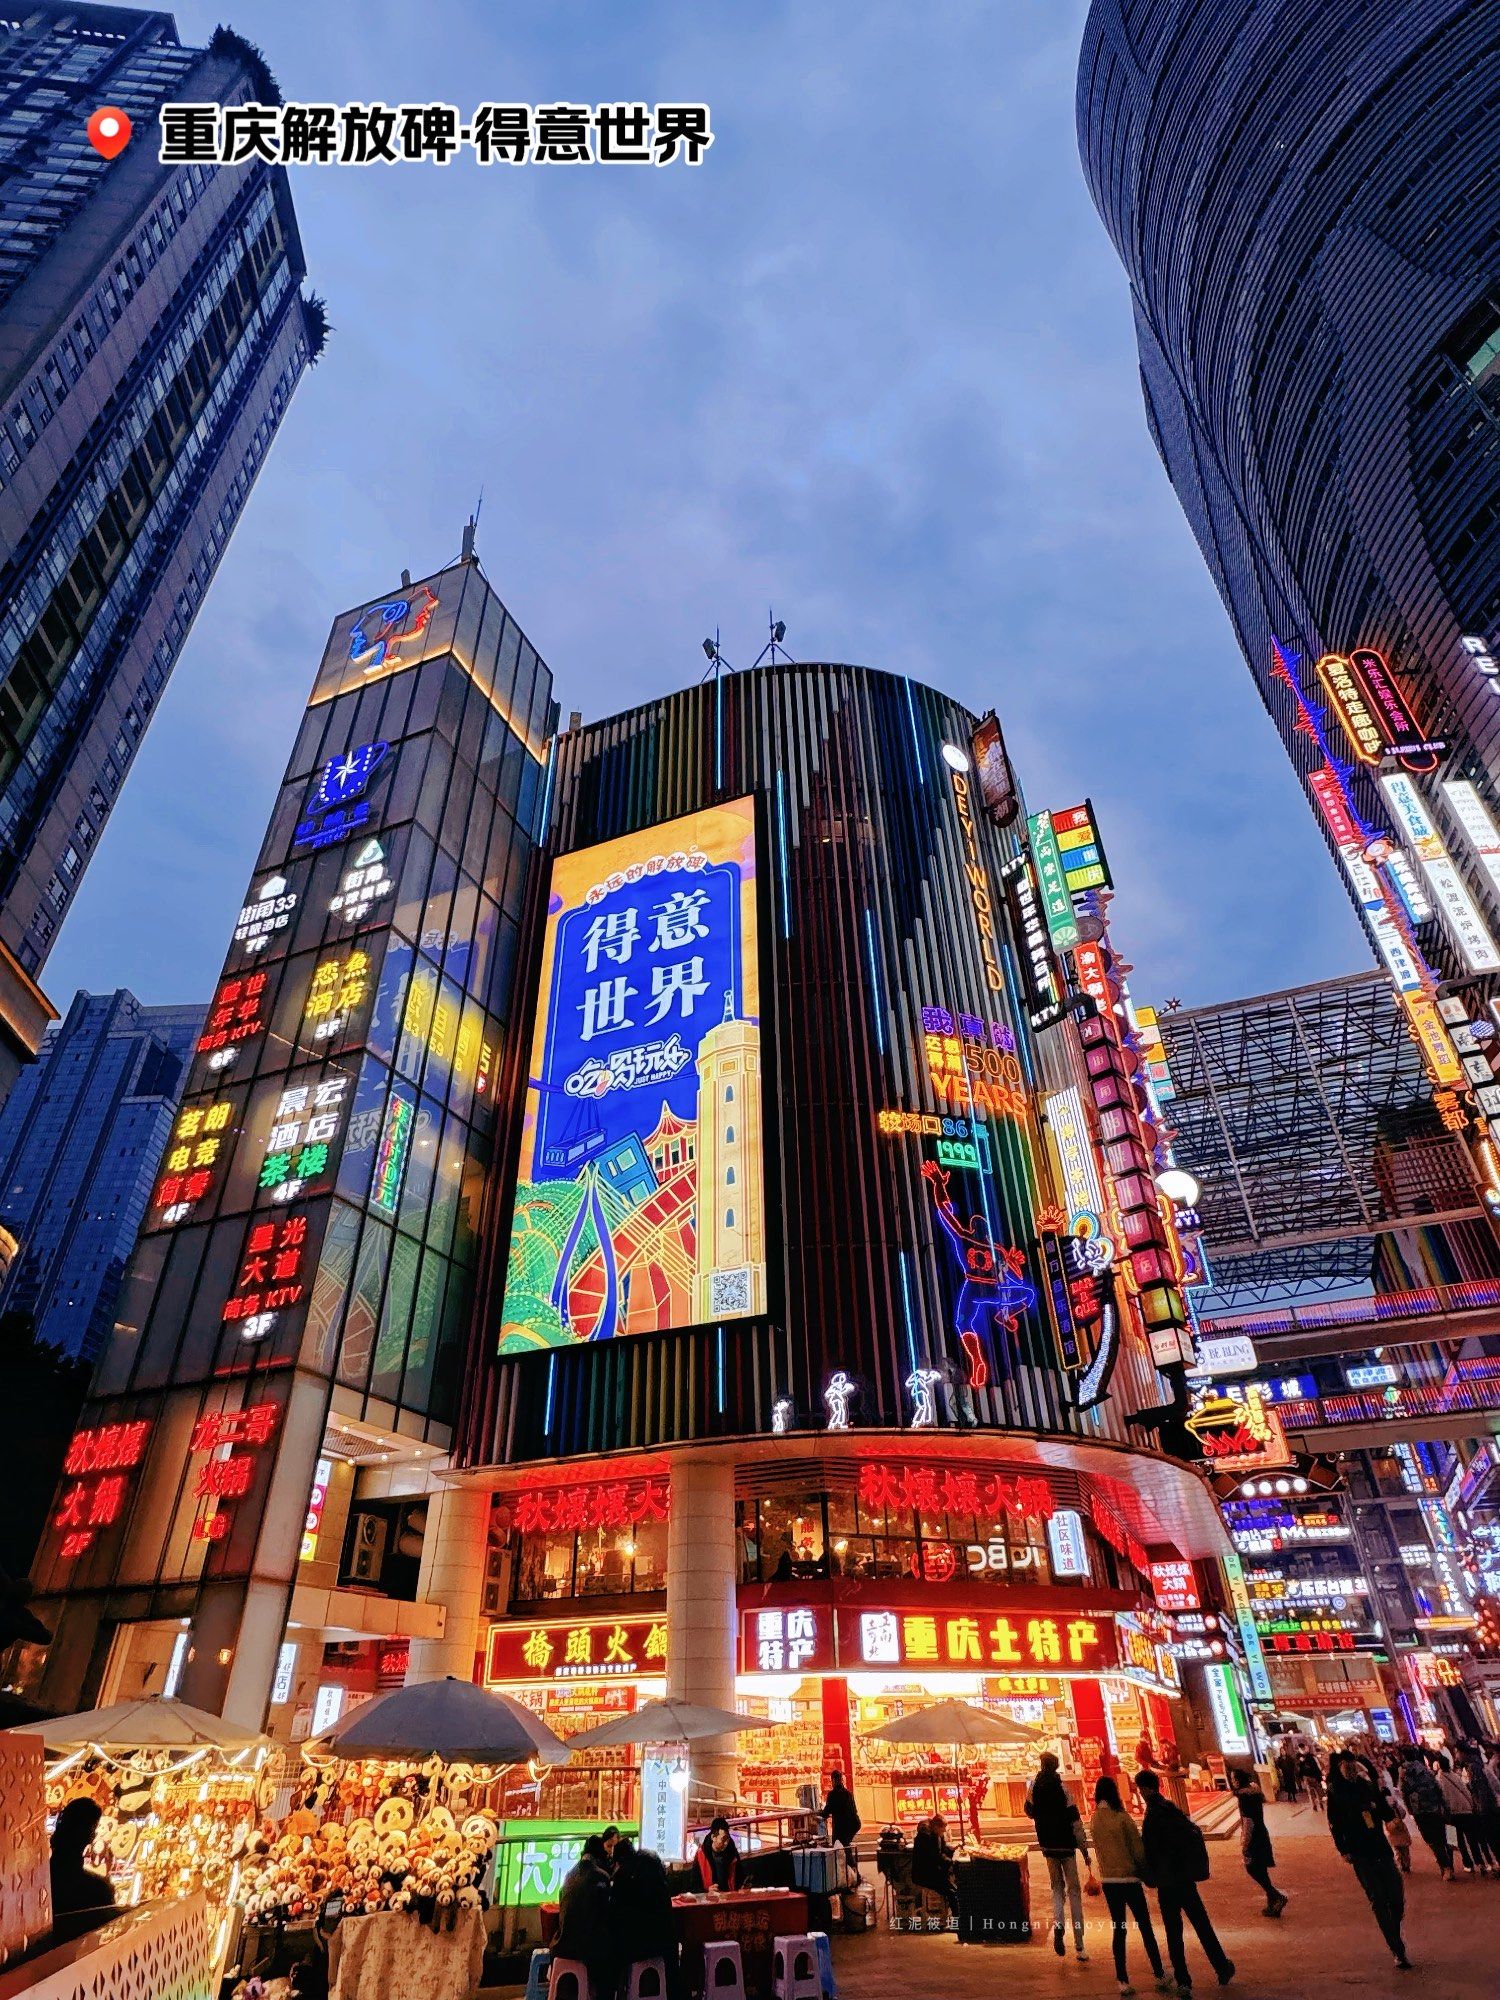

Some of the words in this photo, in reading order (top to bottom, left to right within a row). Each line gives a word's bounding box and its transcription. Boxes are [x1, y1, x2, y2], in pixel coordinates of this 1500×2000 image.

[588, 853, 706, 902] 永远的解放碑
[1001, 853, 1026, 877] KTV
[345, 902, 368, 922] 7F
[965, 863, 1002, 991] WORLD
[246, 935, 269, 953] 7F
[580, 889, 711, 973] 得意
[305, 981, 364, 1018] 酒店
[576, 956, 711, 1041] 世界
[1030, 1002, 1060, 1028] KTV
[231, 1020, 261, 1040] KTV
[314, 1018, 341, 1040] 5F
[921, 1006, 1017, 1053] 我真的
[209, 1047, 238, 1070] 6F
[965, 1043, 1022, 1085] 500
[275, 1077, 347, 1118] 晨宏
[930, 1071, 1028, 1118] YEARS
[266, 1113, 339, 1153] 酒店
[936, 1139, 977, 1162] 1999
[168, 1138, 220, 1171] 电竞
[258, 1144, 329, 1188] 茶楼
[273, 1179, 303, 1201] 4F
[163, 1202, 190, 1223] 4F
[248, 1217, 307, 1253] 星光
[240, 1247, 301, 1288] 大道
[222, 1293, 260, 1321] 商务
[264, 1284, 303, 1309] KTV
[241, 1311, 276, 1340] 3F
[191, 1456, 252, 1501] 火锅
[54, 1474, 126, 1528] 火锅
[59, 1530, 94, 1558] 2F
[1055, 1514, 1076, 1571] 社区味道
[758, 1610, 815, 1640] 重庆
[903, 1616, 1099, 1663] 重庆土特产
[522, 1624, 667, 1667] 橋頭火鍋
[758, 1639, 815, 1670] 特产
[656, 1779, 669, 1855] 中国体育彩票
